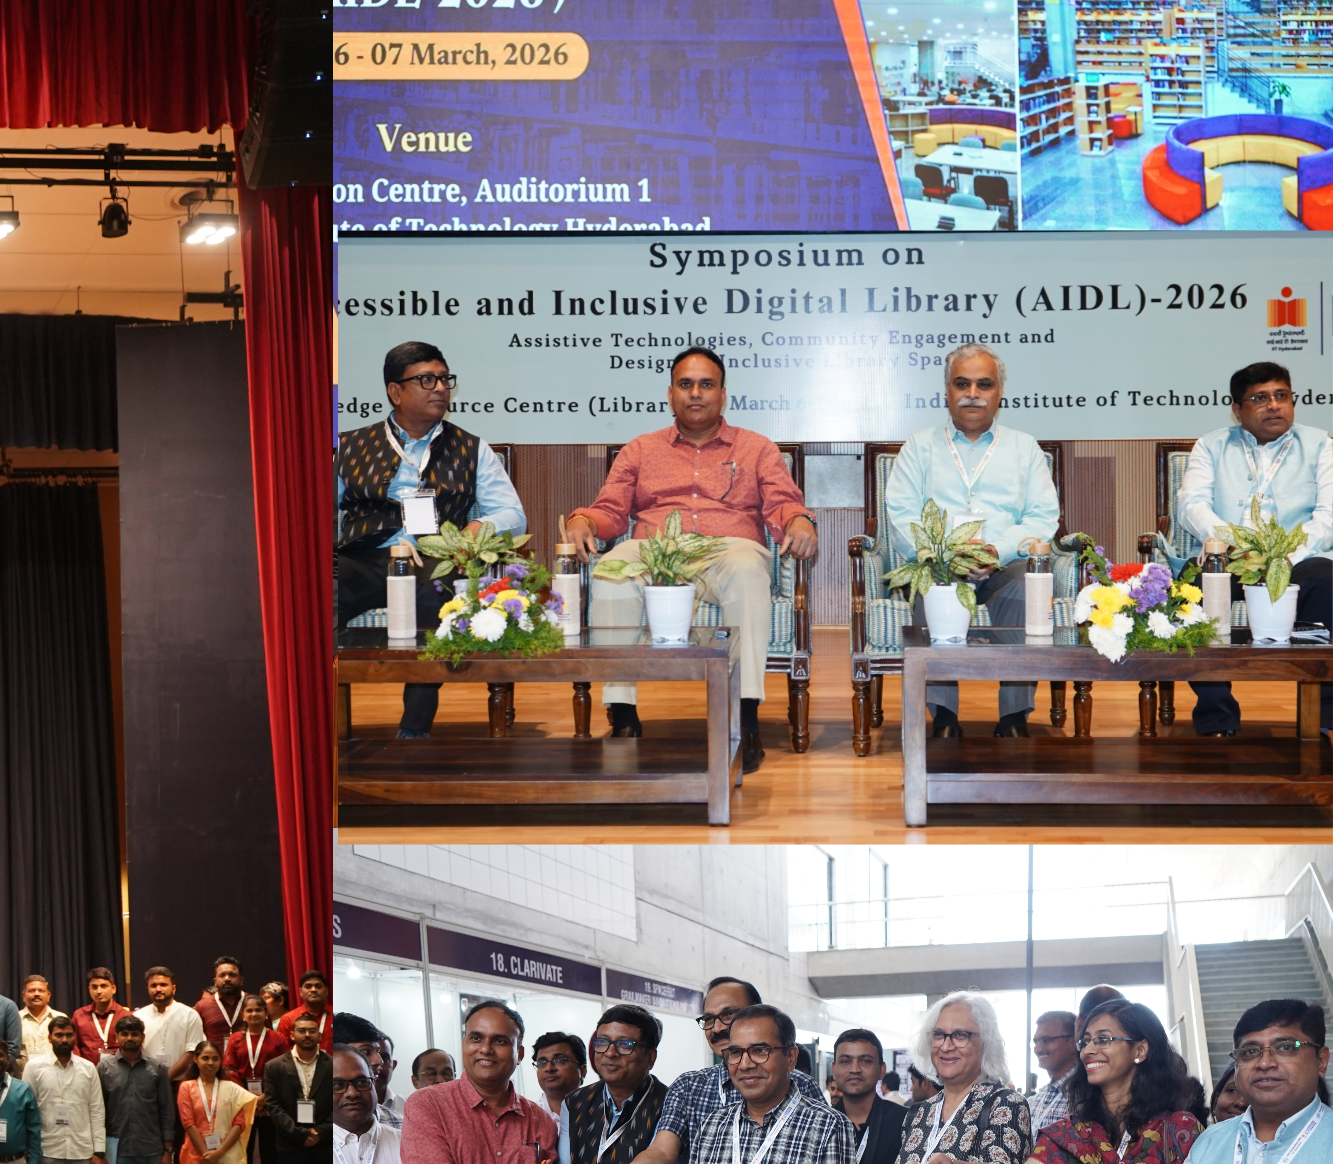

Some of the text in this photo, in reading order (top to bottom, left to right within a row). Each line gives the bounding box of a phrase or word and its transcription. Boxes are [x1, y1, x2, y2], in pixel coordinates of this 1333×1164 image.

[370, 43, 568, 69] 07 March, 2026
[376, 124, 472, 152] Venue
[372, 177, 651, 206] Centre, Auditorium 1
[650, 242, 925, 276] Symposium on
[477, 284, 1248, 321] and Inclusive Digital Library (AIDL)-2026
[508, 333, 602, 348] Assistive
[611, 332, 753, 352] Technologies,
[889, 331, 1012, 351] Engagement
[1019, 330, 1055, 344] and
[504, 390, 1119, 413] Centre of
[490, 952, 563, 984] 18. CLARIVATE
